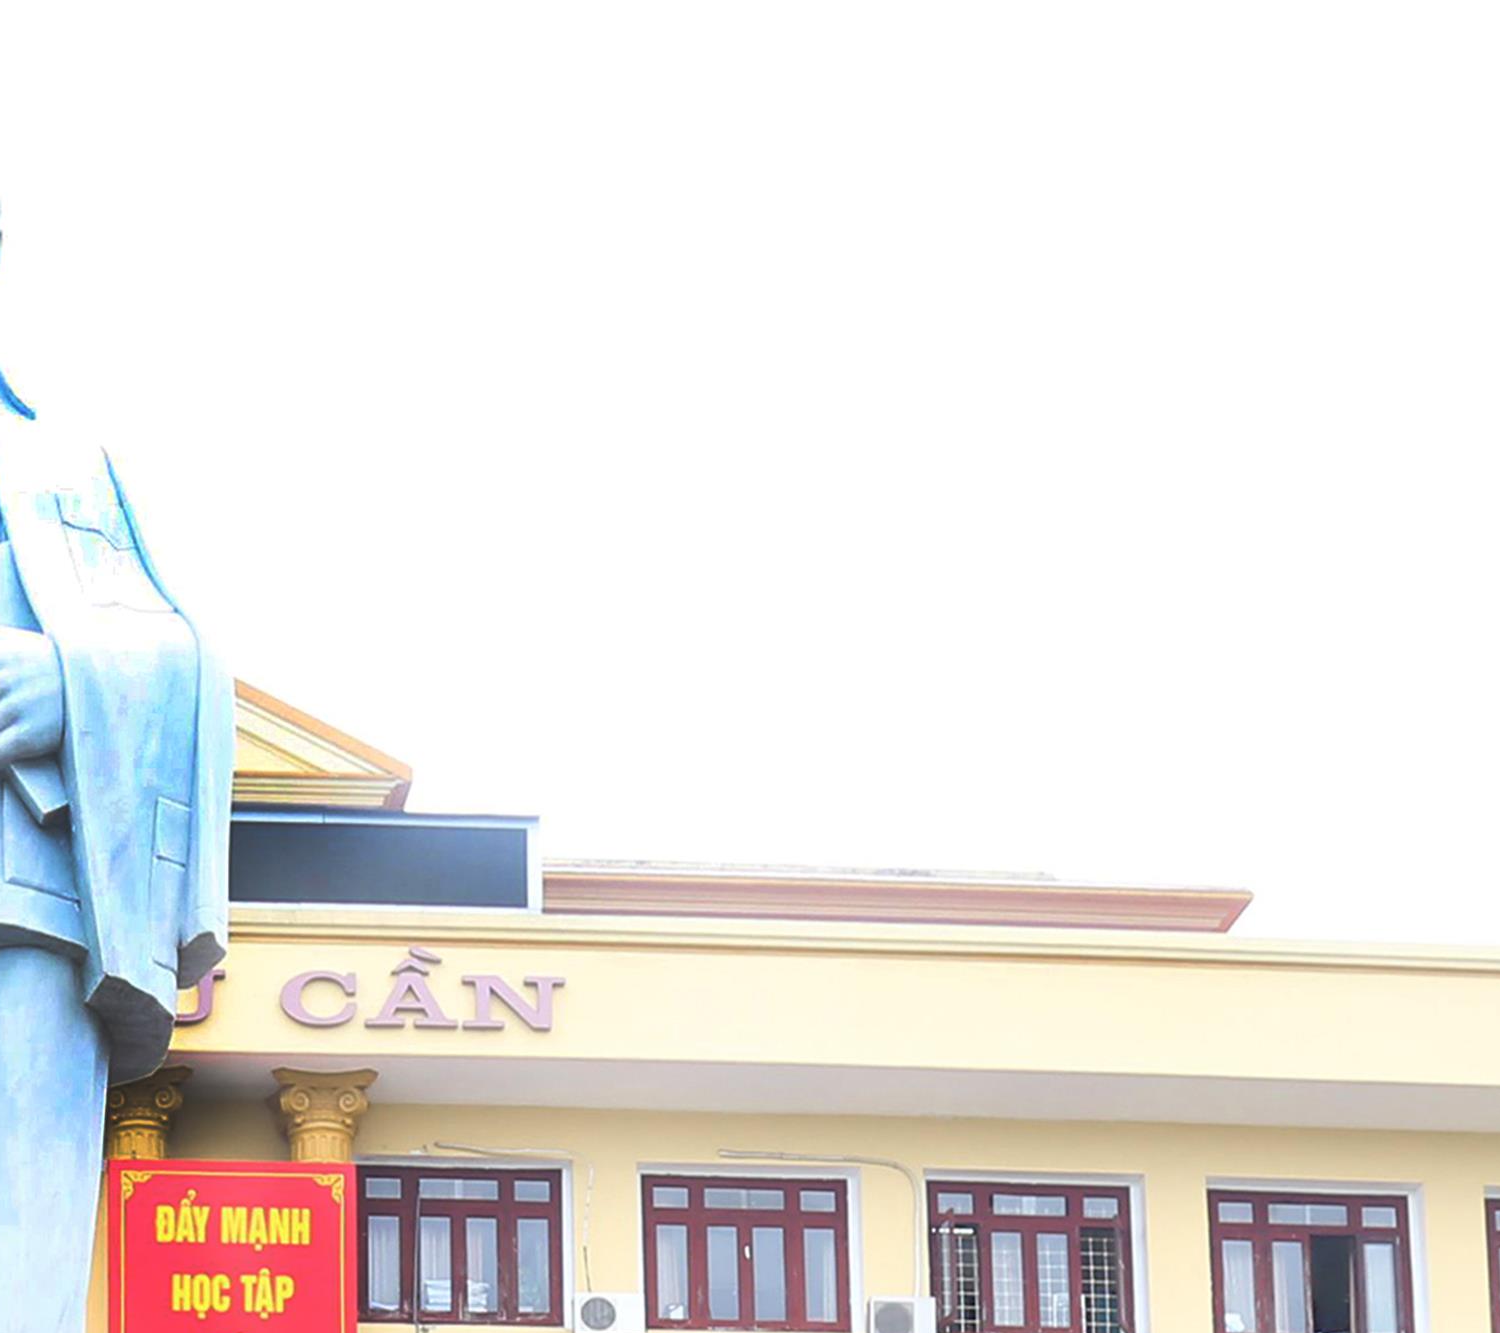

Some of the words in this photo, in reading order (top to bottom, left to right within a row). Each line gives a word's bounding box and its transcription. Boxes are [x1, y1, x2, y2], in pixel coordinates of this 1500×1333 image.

[280, 946, 566, 1031] CẦN
[155, 1189, 210, 1244] ĐẨY
[220, 1206, 311, 1251] MẠNH
[171, 1273, 232, 1320] HỌC
[240, 1267, 295, 1320] TẬP
